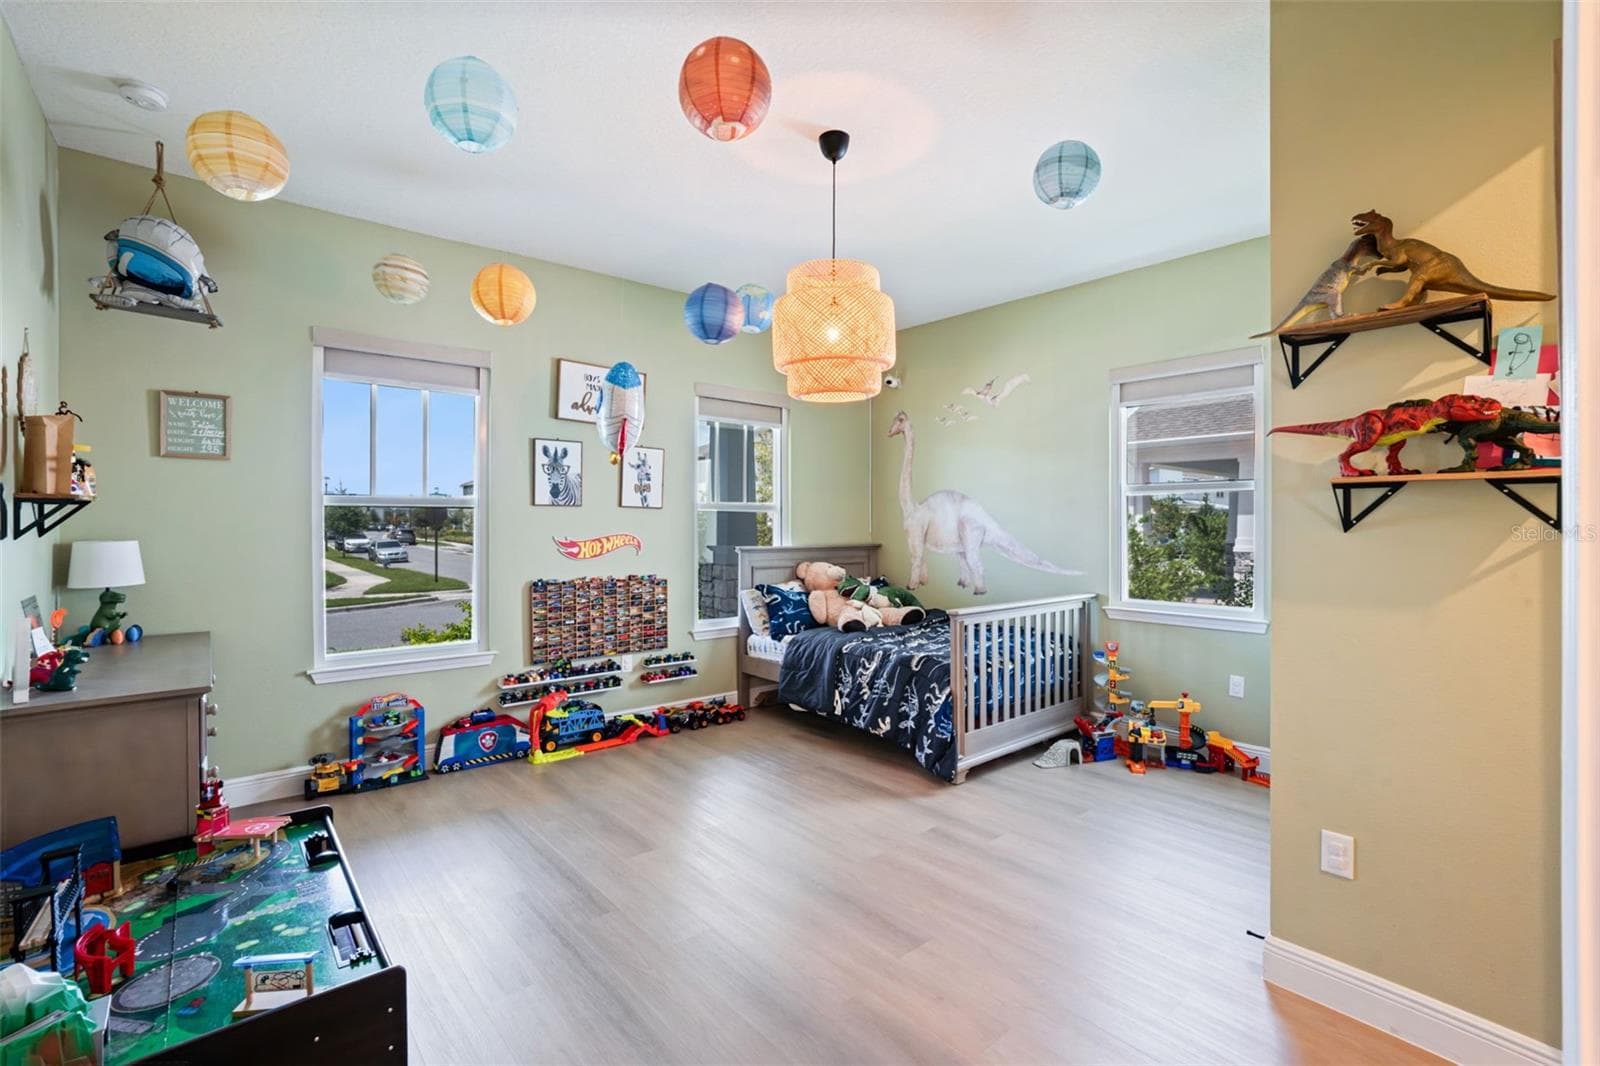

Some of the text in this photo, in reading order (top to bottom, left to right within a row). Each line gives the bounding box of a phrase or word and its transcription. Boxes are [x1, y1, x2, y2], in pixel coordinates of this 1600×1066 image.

[167, 397, 225, 410] WELCOME
[577, 533, 638, 559] HOT WHEELS
